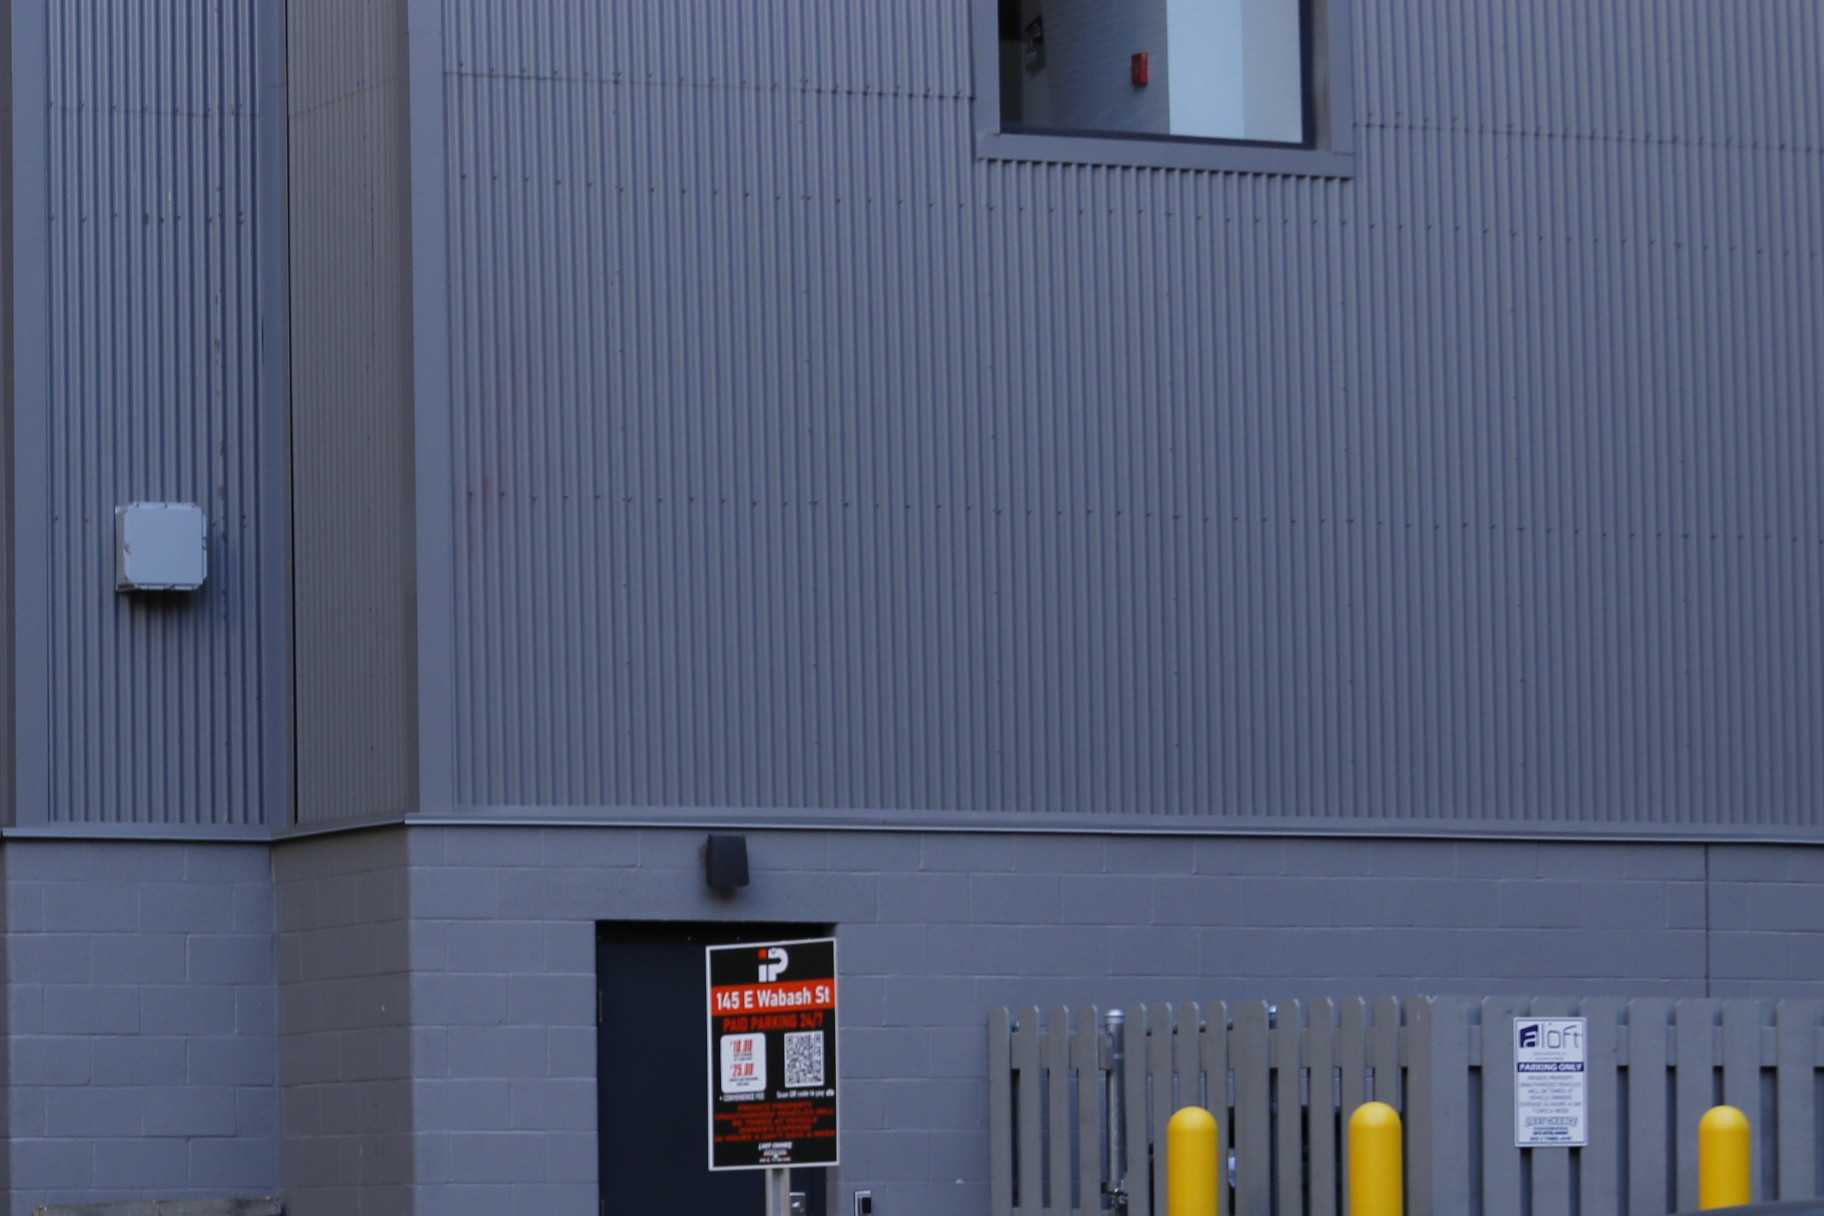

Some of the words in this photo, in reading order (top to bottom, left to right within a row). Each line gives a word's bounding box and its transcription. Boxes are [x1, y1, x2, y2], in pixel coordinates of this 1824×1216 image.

[716, 991, 740, 1010] 145
[743, 990, 754, 1009] E
[757, 987, 811, 1008] Wabash
[815, 985, 830, 1004] St
[751, 1013, 797, 1031] PARKING
[799, 1011, 824, 1028] 24/7
[1519, 1063, 1557, 1072] PARKING
[1558, 1063, 1583, 1072] ONLY
